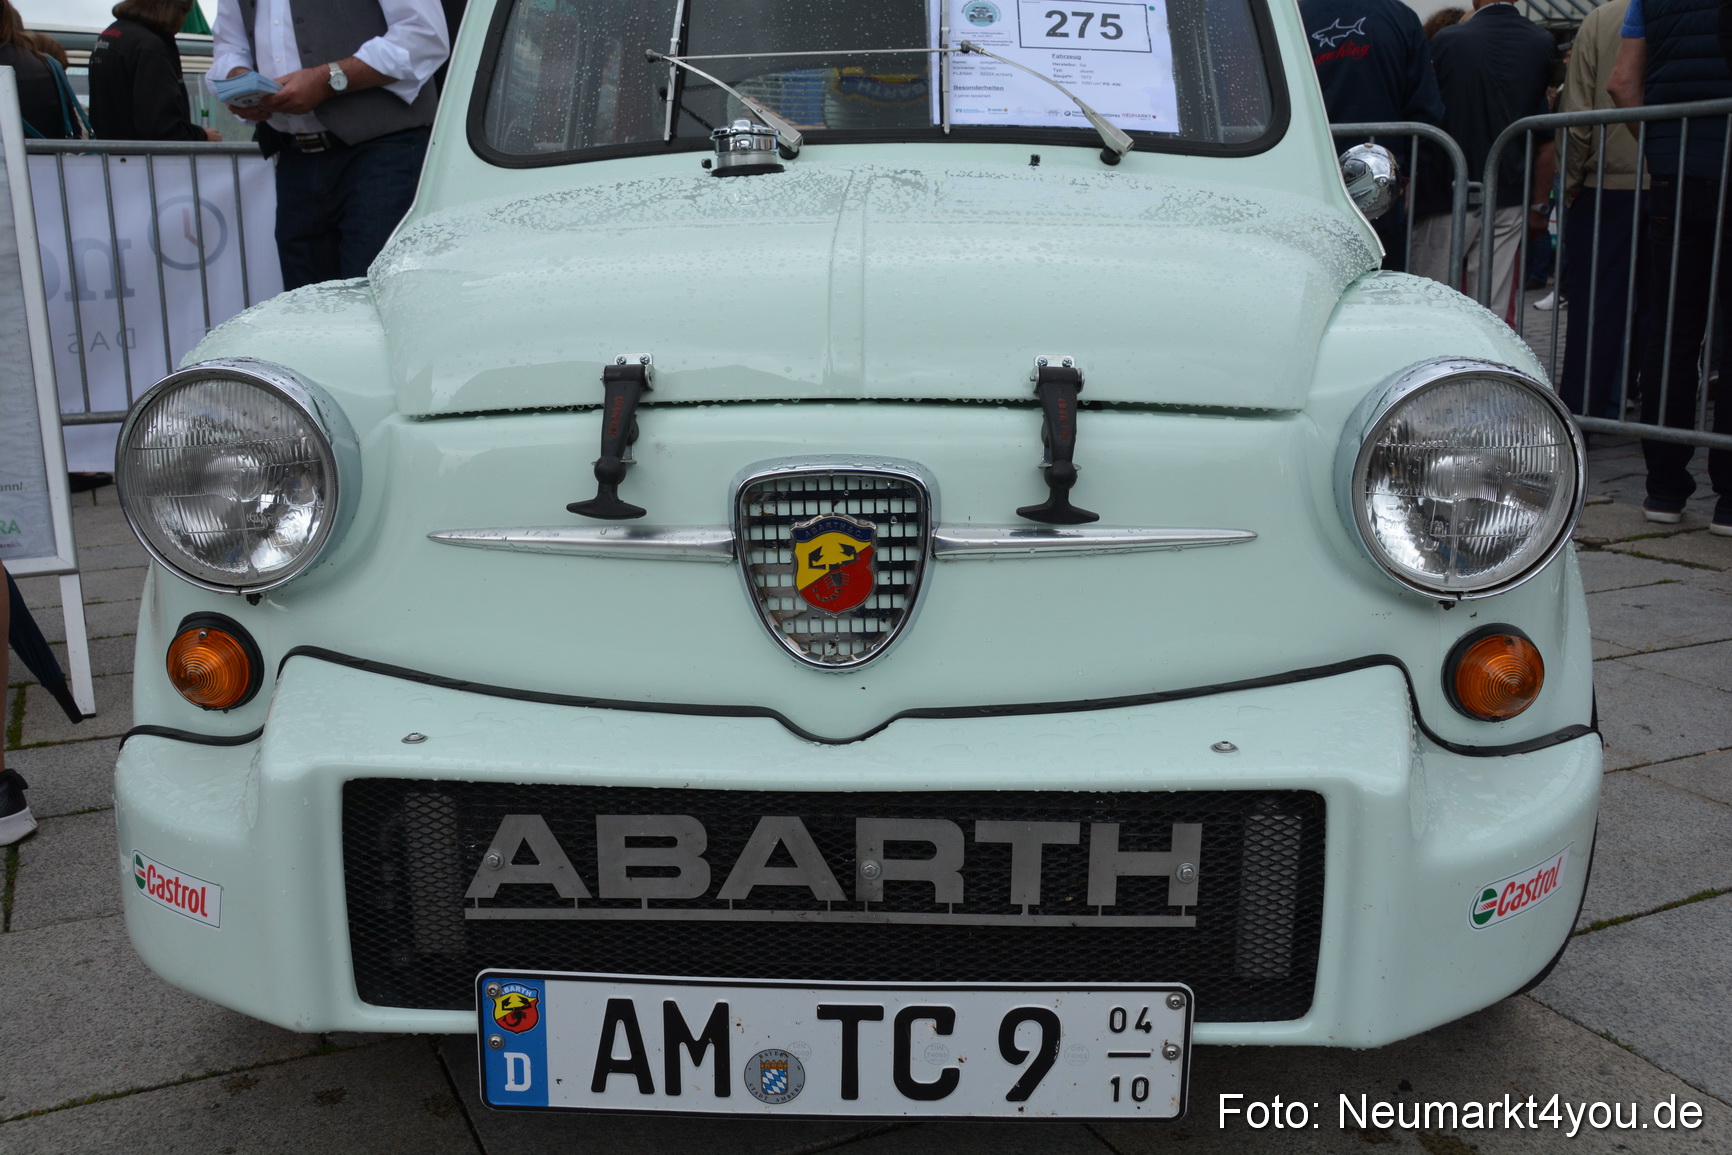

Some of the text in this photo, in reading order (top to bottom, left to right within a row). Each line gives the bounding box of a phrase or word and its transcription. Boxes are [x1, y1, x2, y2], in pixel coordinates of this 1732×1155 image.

[1045, 10, 1124, 40] 275
[857, 80, 928, 98] BARTH
[804, 521, 846, 538] ABARTH
[464, 814, 1202, 906] ABARTH
[147, 864, 208, 918] Castrol
[1497, 856, 1562, 917] Castrol
[1108, 1006, 1153, 1034] 04
[591, 997, 1062, 1102] AM TC 9
[758, 1051, 790, 1059] BAYERN
[503, 1052, 532, 1092] D
[748, 1083, 802, 1102] STADT AMBERG
[1110, 1075, 1150, 1102] 10
